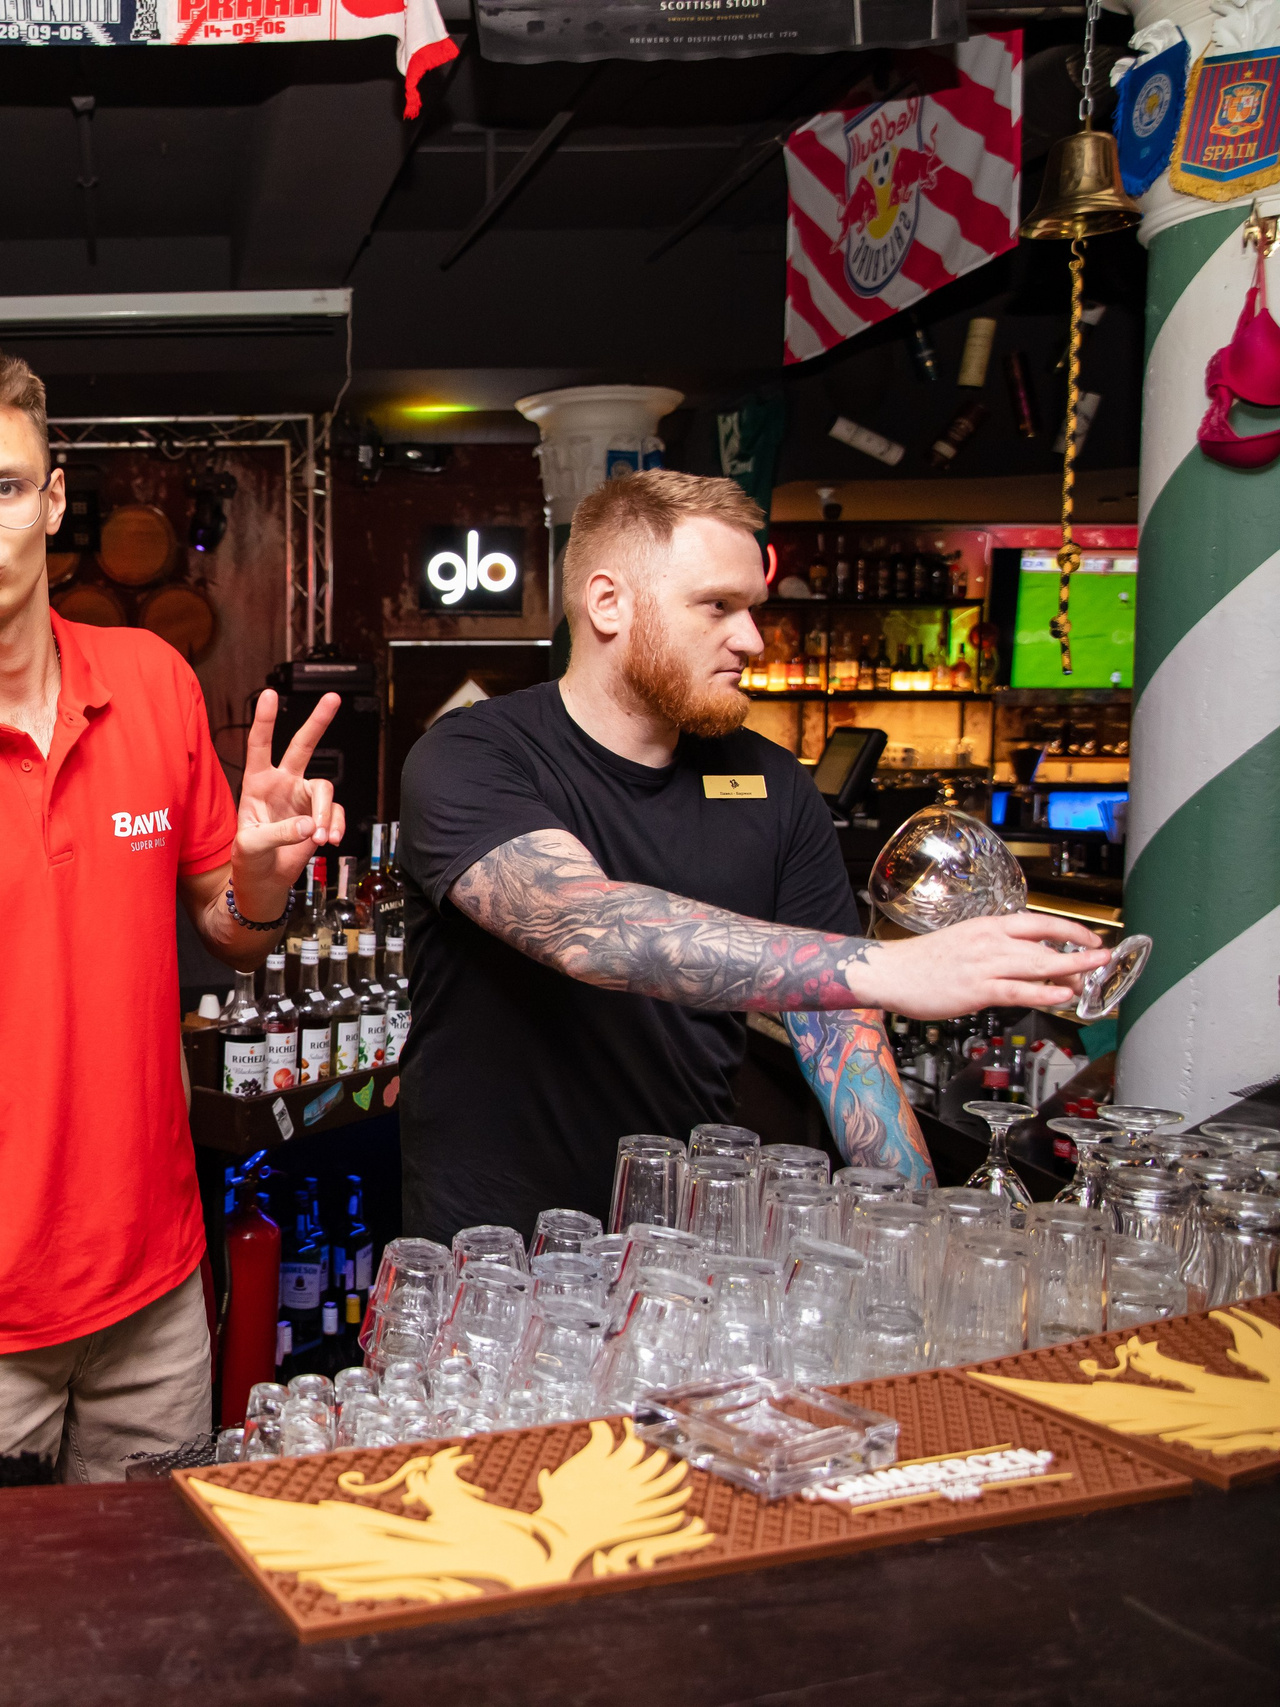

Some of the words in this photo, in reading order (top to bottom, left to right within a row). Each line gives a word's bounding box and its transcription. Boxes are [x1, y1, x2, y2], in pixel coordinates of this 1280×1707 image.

[659, 0, 721, 11] SCOTTISH
[203, 21, 286, 38] 14-09-06
[629, 37, 670, 45] BREWERS
[687, 34, 744, 43] DISTINCTION
[747, 32, 774, 41] SINCE
[1202, 142, 1258, 163] SPAIN
[427, 529, 517, 605] glo
[111, 807, 172, 838] BAVIK
[130, 839, 154, 852] SUPER
